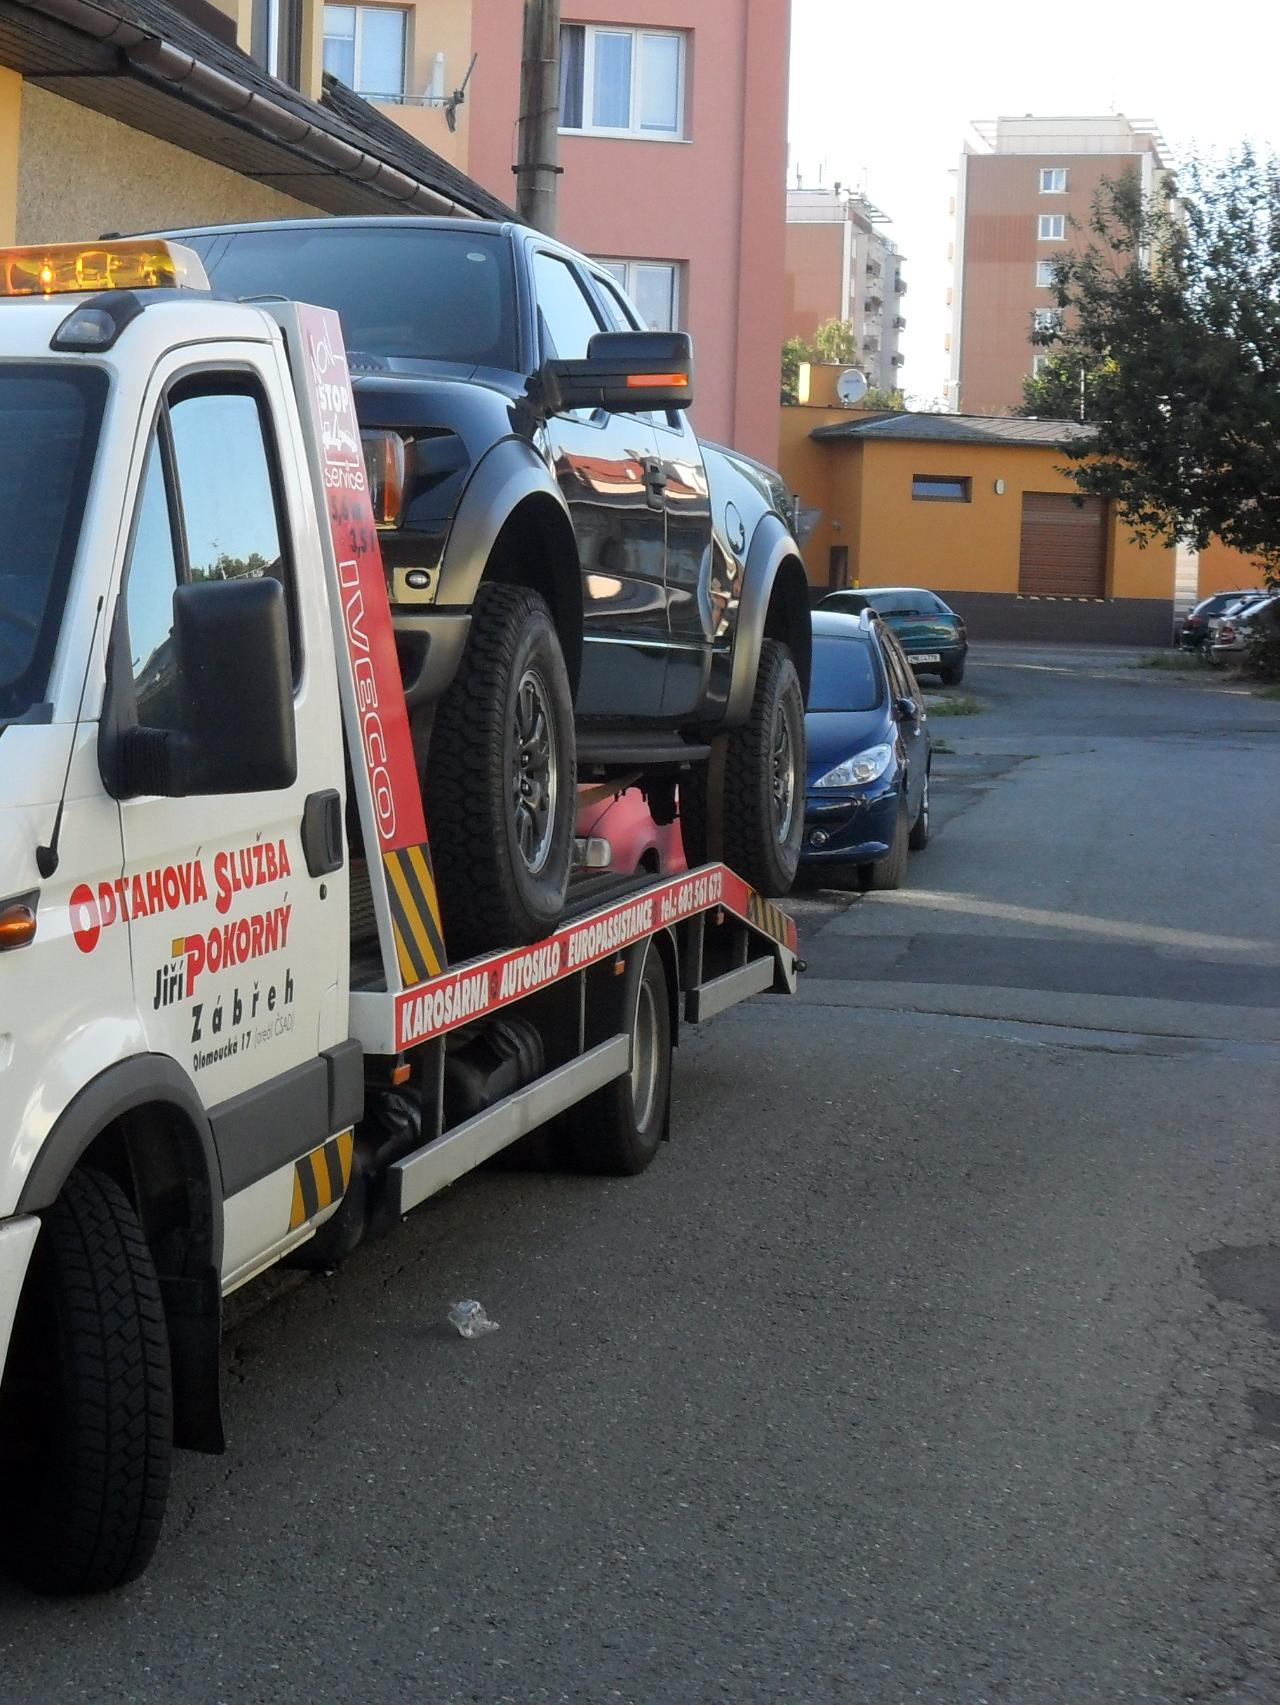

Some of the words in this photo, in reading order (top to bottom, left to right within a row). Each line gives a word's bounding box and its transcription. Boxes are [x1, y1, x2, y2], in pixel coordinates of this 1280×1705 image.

[318, 384, 348, 413] STOP
[324, 467, 365, 492] service
[338, 559, 396, 840] IVECO
[69, 846, 208, 954] ODTAHOVÁ
[214, 831, 291, 915] SLUŽBA
[153, 959, 184, 1010] Jiří
[183, 890, 292, 998] POKORNÝ
[401, 971, 489, 1044] KAROSÁRNA
[499, 940, 561, 1000] AUTOSKLO
[568, 898, 654, 968] EUROPASSISTANCE
[677, 881, 694, 915] 603
[693, 876, 708, 909] 561
[190, 968, 294, 1044] Zábřeh
[193, 1033, 238, 1073] Olomoucká
[241, 1030, 252, 1051] 17
